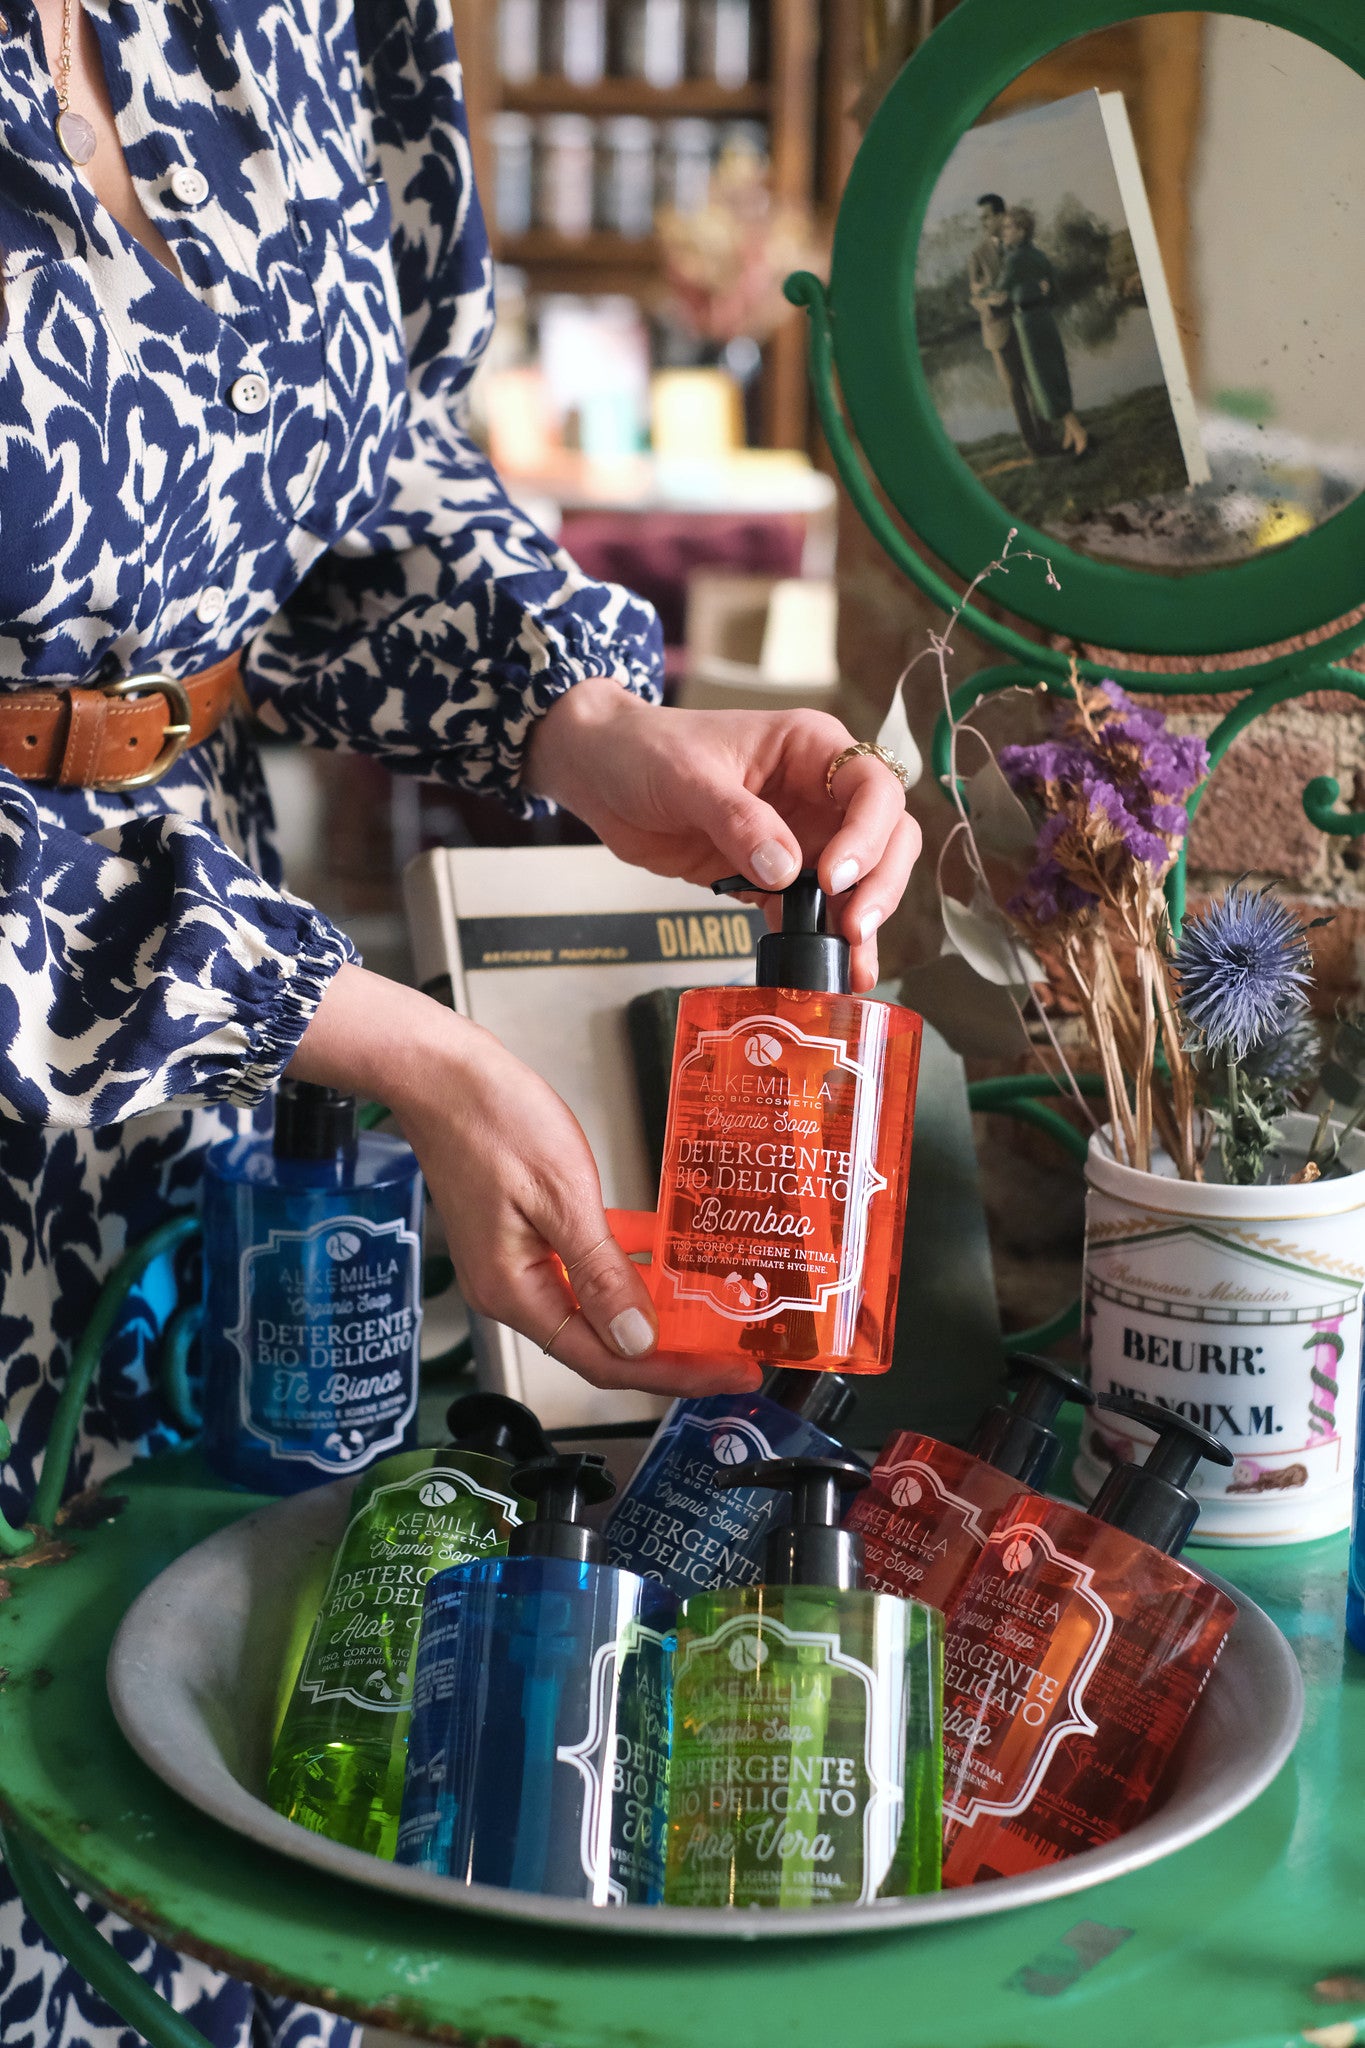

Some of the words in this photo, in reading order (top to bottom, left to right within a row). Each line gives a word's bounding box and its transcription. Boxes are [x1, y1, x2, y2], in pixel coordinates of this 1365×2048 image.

[656, 914, 751, 958] DIARIO
[699, 1074, 832, 1101] ALKEMILLA
[730, 1095, 750, 1103] BIO
[756, 1096, 822, 1110] COSMETIC
[704, 1106, 768, 1134] Organic
[773, 1110, 820, 1139] Soap
[677, 1138, 851, 1176] DETERGENTE
[675, 1166, 708, 1189] BIO
[716, 1166, 850, 1202] DELICATO
[692, 1197, 816, 1238] Bamboo
[696, 1241, 734, 1253] CORPO
[738, 1244, 745, 1254] E
[749, 1245, 791, 1258] IGIENE
[794, 1250, 839, 1264] INTIMA.
[697, 1255, 719, 1264] BODY
[720, 1256, 739, 1266] AND
[741, 1258, 785, 1270] INTIMATE
[787, 1263, 829, 1274] HYGIENE.
[279, 1258, 399, 1286] ALKEMILLA
[288, 1296, 354, 1320] Organic
[258, 1306, 413, 1346] DETERGENTE
[258, 1345, 300, 1367] BIO
[310, 1330, 413, 1369] DELICATO
[318, 1369, 403, 1404] Bianco
[655, 1478, 708, 1518] Organic
[709, 1505, 749, 1542] Soap
[683, 1476, 700, 1489] BIO
[704, 1487, 760, 1522] COSMETIC
[369, 1512, 498, 1546] ALKEMILLA
[424, 1530, 488, 1550] COSMETIC
[607, 1520, 637, 1547] BIO
[863, 1524, 878, 1534] BIO
[881, 1531, 935, 1562] COSMETIC
[370, 1540, 434, 1561] Organic
[884, 1547, 924, 1583] Soap
[329, 1591, 365, 1617] BIO
[991, 1599, 1046, 1628] COSMETIC
[330, 1612, 396, 1647] Aloe
[994, 1615, 1035, 1651] Soap
[343, 1646, 382, 1658] CORPO
[343, 1658, 367, 1667] BODY
[367, 1658, 386, 1666] AND
[944, 1632, 1060, 1704] TERGENTE
[689, 1680, 827, 1704] ALKEMILLA
[762, 1717, 813, 1747] Soap
[612, 1763, 649, 1800] BIO
[675, 1755, 857, 1788] DETERGENTE
[708, 1786, 857, 1817] DELICATO
[745, 1817, 836, 1862] Vera
